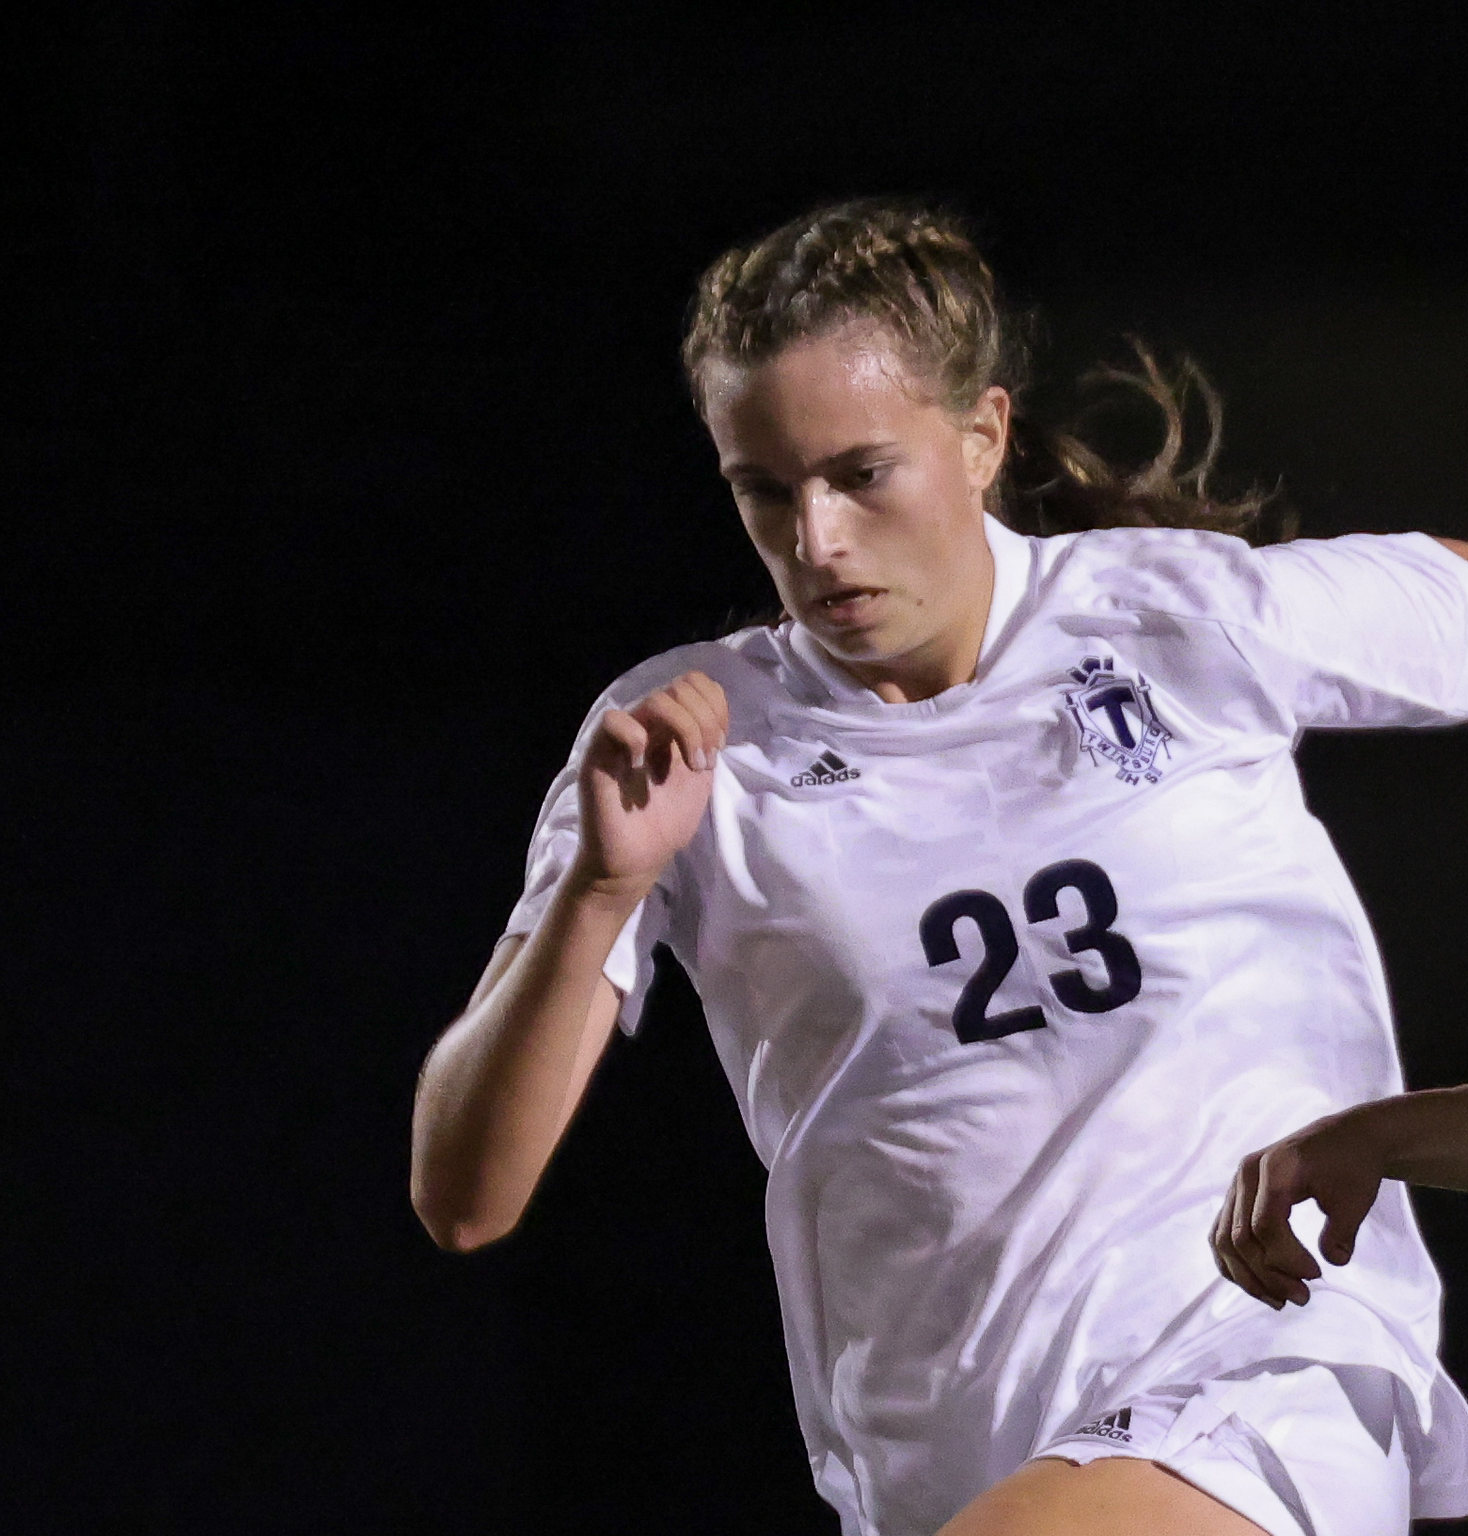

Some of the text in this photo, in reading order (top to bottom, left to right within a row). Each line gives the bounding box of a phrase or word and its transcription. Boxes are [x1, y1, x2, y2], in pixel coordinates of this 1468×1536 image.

[1085, 687, 1137, 749] T
[1088, 727, 1161, 769] TWINSBURG
[790, 768, 862, 787] adidas
[919, 858, 1142, 1045] 23
